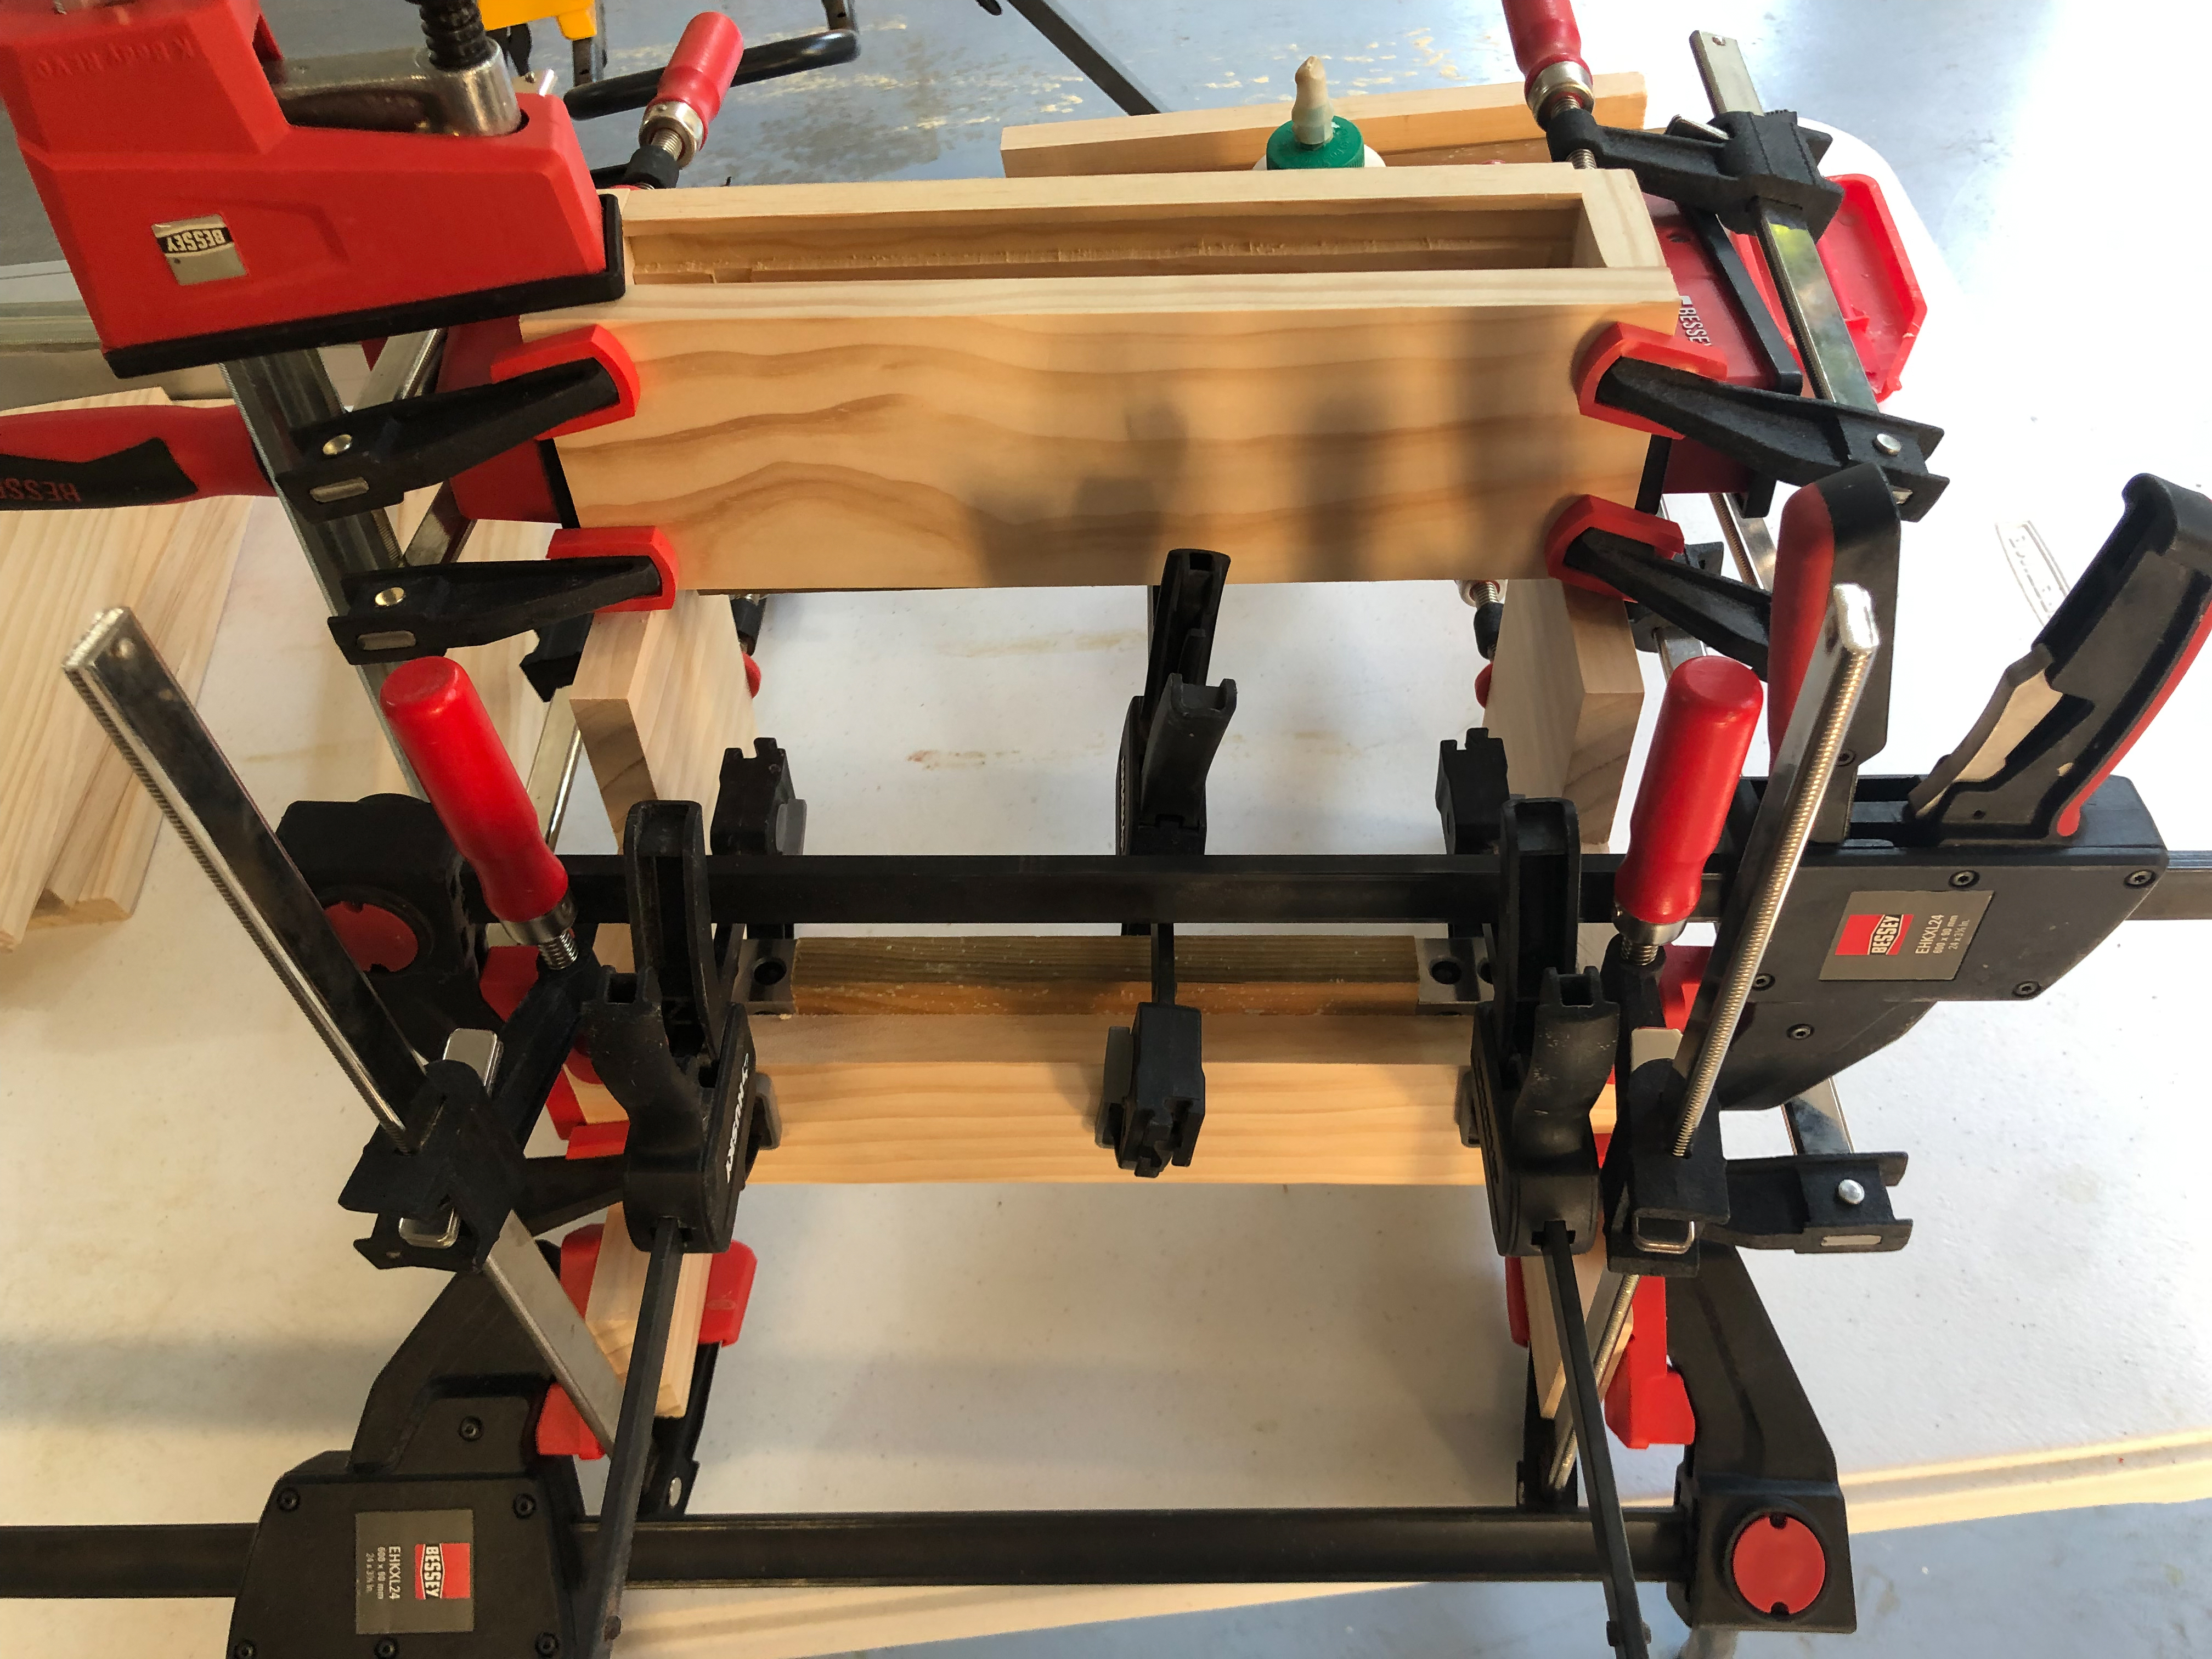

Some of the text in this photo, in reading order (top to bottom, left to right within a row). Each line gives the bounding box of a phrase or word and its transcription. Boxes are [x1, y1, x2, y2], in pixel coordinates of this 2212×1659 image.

[167, 229, 226, 252] BESSEY
[1871, 916, 1900, 953] BESSEY
[1915, 914, 1945, 954] EHKXL24
[388, 1546, 402, 1600] EHKXL24
[424, 1546, 441, 1597] BESSEY
